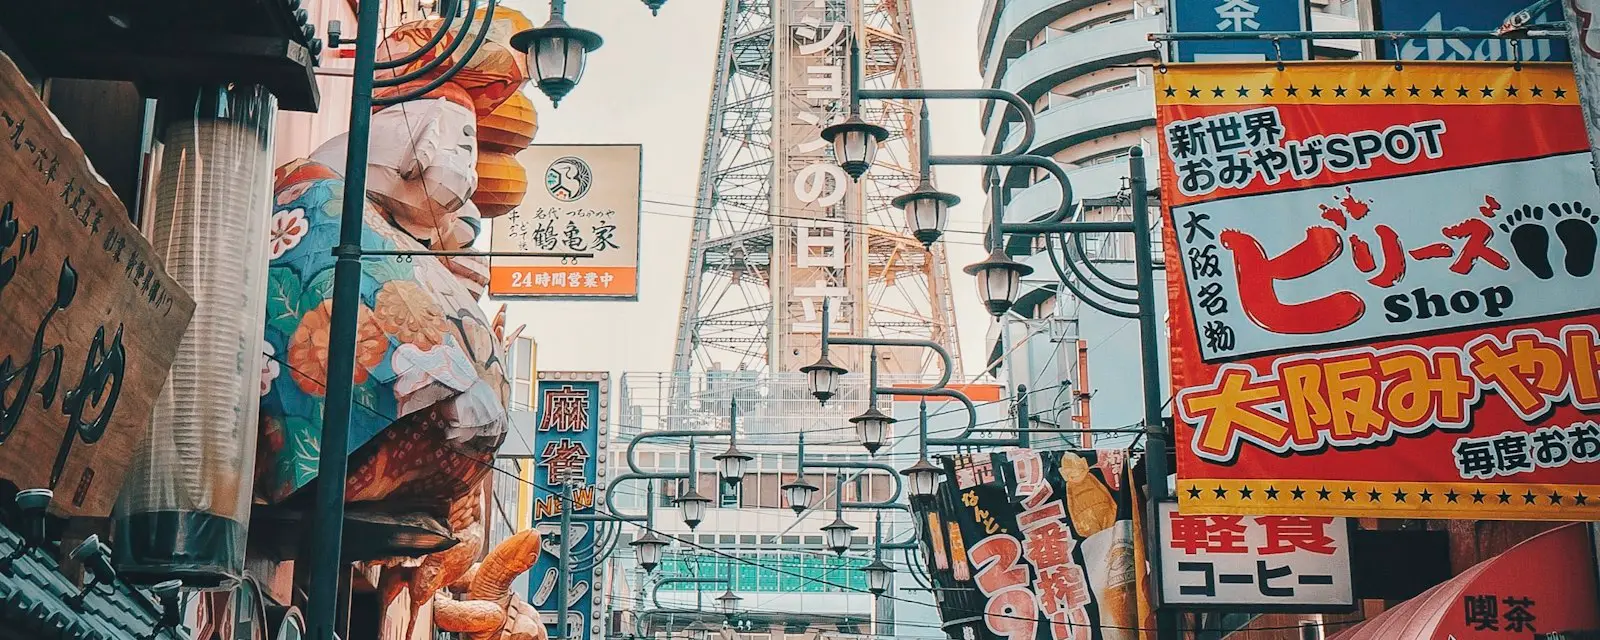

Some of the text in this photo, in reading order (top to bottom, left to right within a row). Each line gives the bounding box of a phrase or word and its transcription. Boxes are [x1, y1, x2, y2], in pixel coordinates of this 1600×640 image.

[1168, 109, 1283, 161] 新世界
[1178, 122, 1445, 194] おみやげSPOT
[1, 110, 61, 186] 一九一六年
[60, 178, 104, 236] 大正五年
[532, 219, 620, 251] 鶴亀家
[511, 271, 614, 289] 24時間営業中
[1183, 210, 1236, 354] 大阪名物
[1219, 188, 1511, 335] ビリーズ
[537, 384, 590, 487] 麻雀
[1169, 511, 1337, 556] 軽食
[1178, 560, 1333, 597] コーヒー
[1463, 594, 1537, 633] 喫茶
